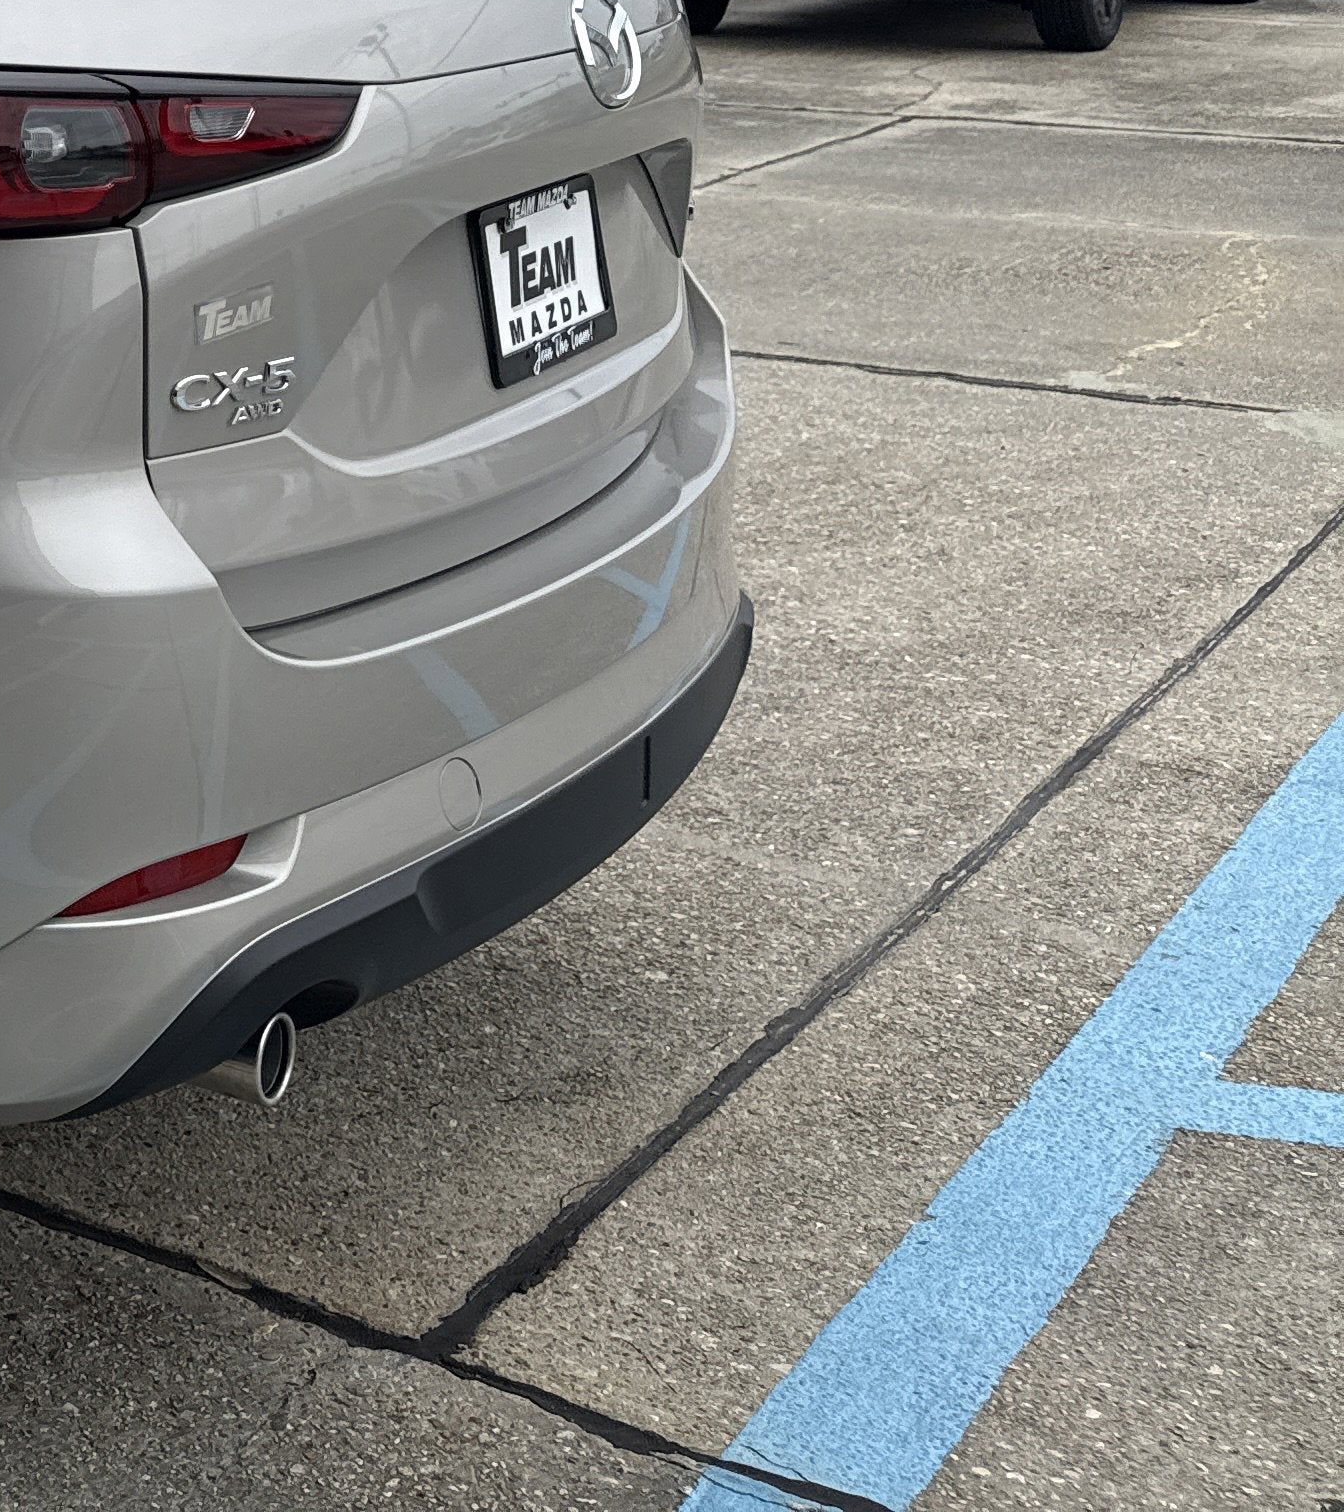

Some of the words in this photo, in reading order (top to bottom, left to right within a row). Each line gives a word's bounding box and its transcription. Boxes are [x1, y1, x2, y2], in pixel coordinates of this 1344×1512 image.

[508, 195, 536, 221] TEAM
[536, 184, 569, 213] MAZDA
[500, 225, 578, 310] TEAM
[198, 294, 274, 341] TEAM
[508, 289, 588, 346] MAZDA
[533, 340, 553, 375] Join
[551, 332, 570, 359] The
[170, 356, 297, 412] CX-5
